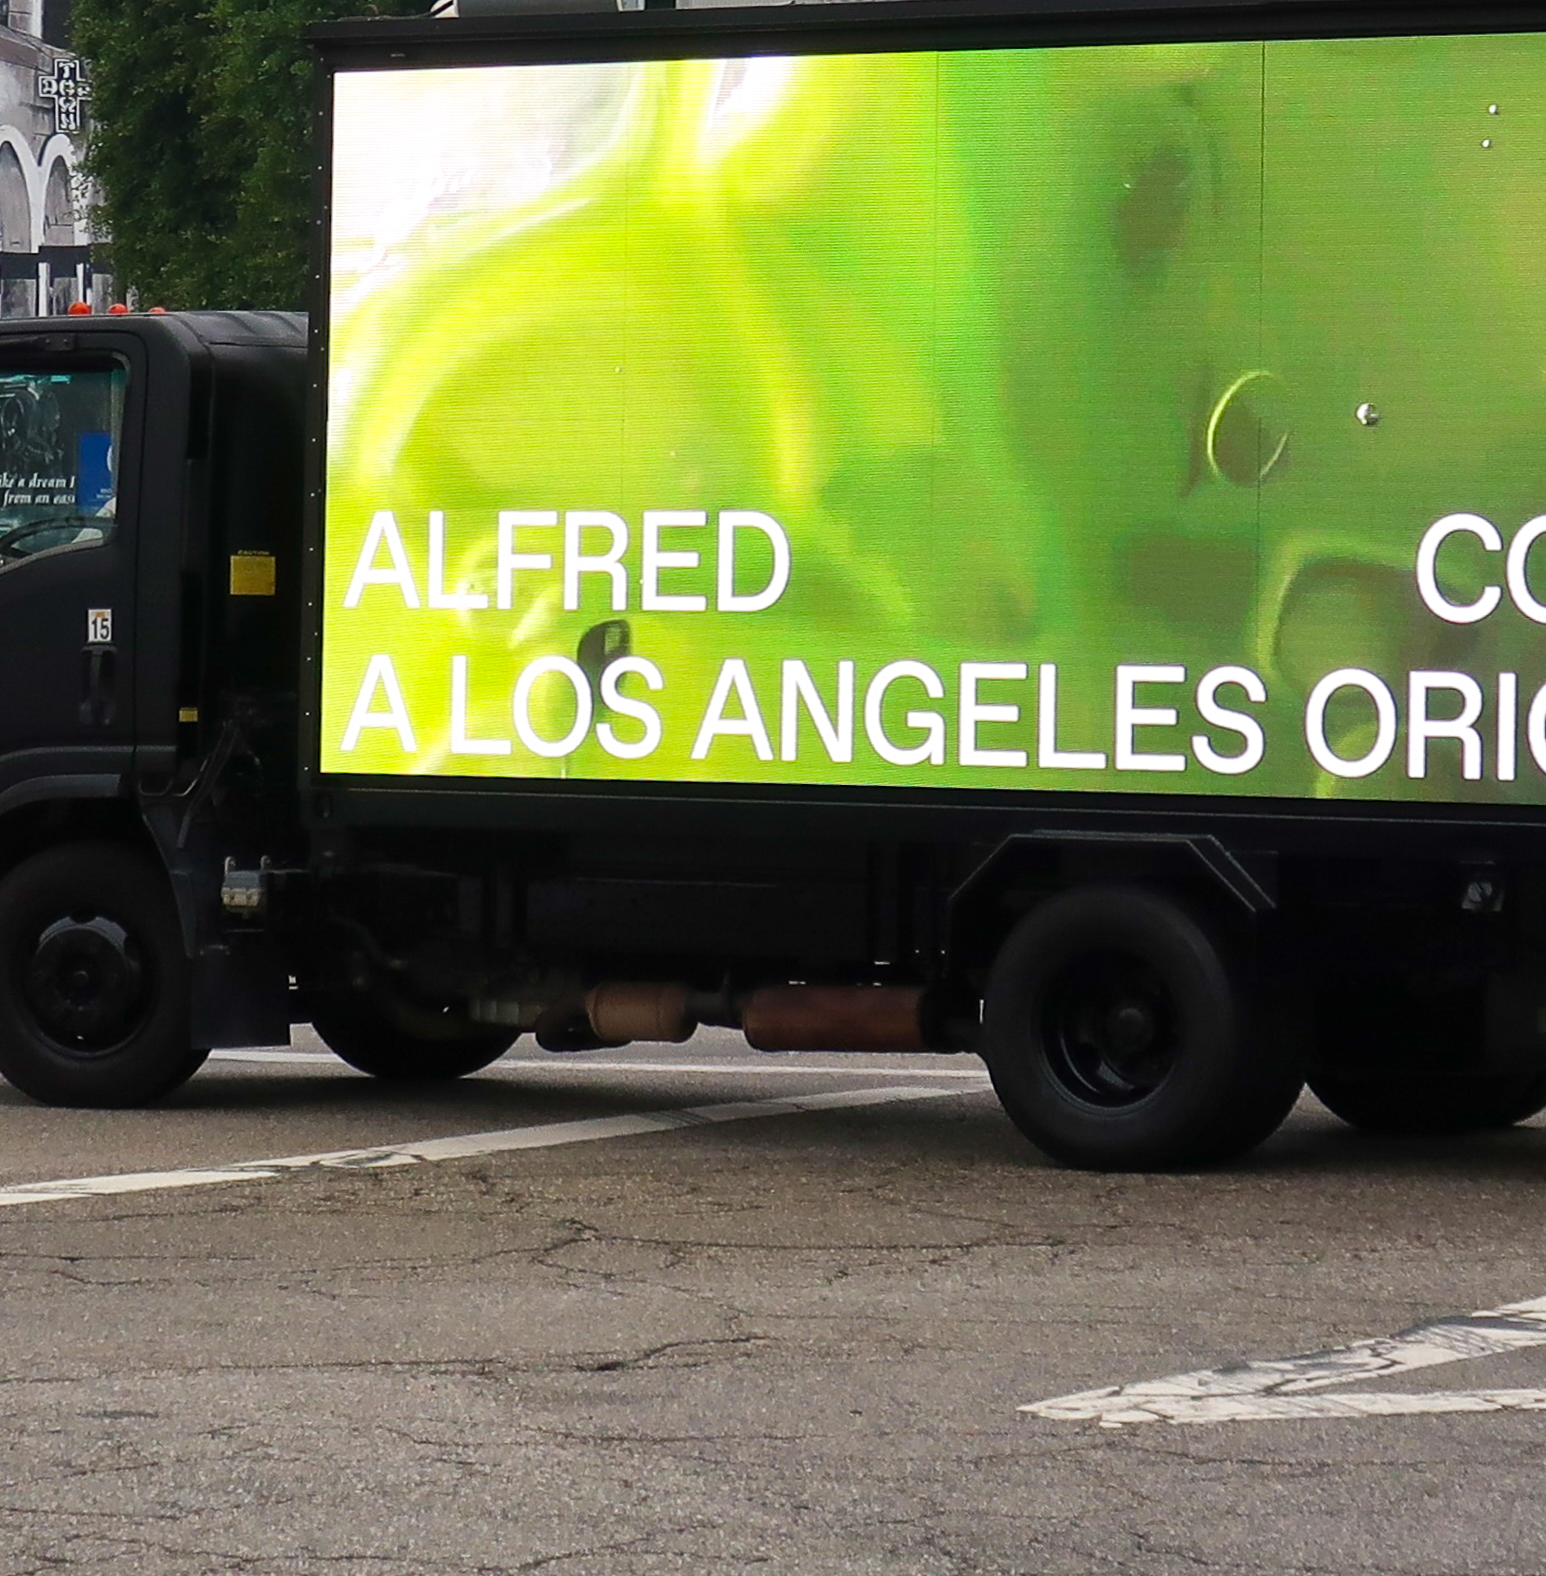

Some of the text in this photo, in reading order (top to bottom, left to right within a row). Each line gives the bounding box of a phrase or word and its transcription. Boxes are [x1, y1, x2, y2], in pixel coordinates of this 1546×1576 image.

[18, 479, 25, 488] a
[28, 472, 66, 488] dream
[34, 493, 50, 504] an
[344, 510, 791, 613] ALFRED
[91, 617, 110, 640] 15
[340, 654, 416, 754] A
[450, 655, 663, 759] LOS
[691, 657, 1267, 777] ANGELES
